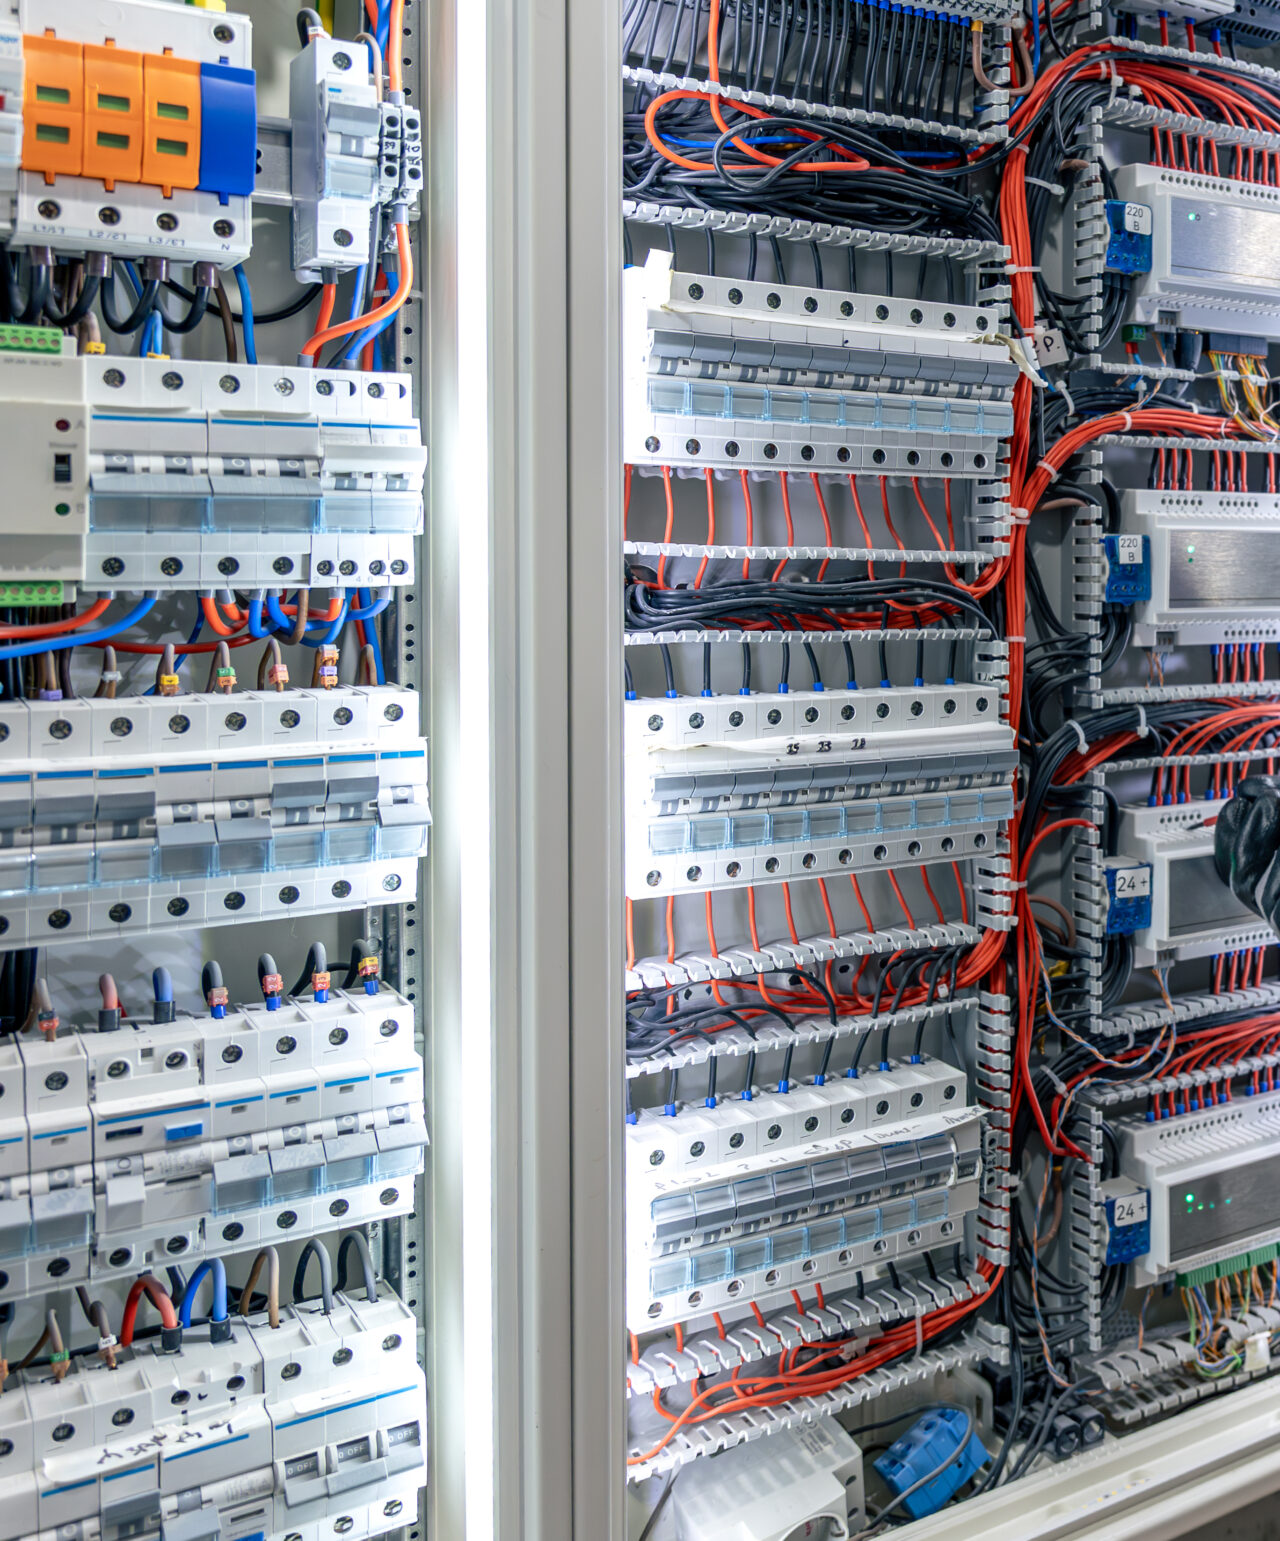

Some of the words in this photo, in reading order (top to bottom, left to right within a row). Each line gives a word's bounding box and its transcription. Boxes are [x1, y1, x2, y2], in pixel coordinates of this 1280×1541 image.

[1126, 205, 1143, 218] 220
[1133, 221, 1140, 231] B
[1120, 538, 1138, 548] 220
[1128, 552, 1135, 561] B
[1117, 876, 1136, 892] 24
[1116, 1203, 1135, 1221] 24
[397, 1430, 414, 1440] OFF
[347, 1445, 365, 1456] OFF
[296, 1462, 315, 1472] OFF
